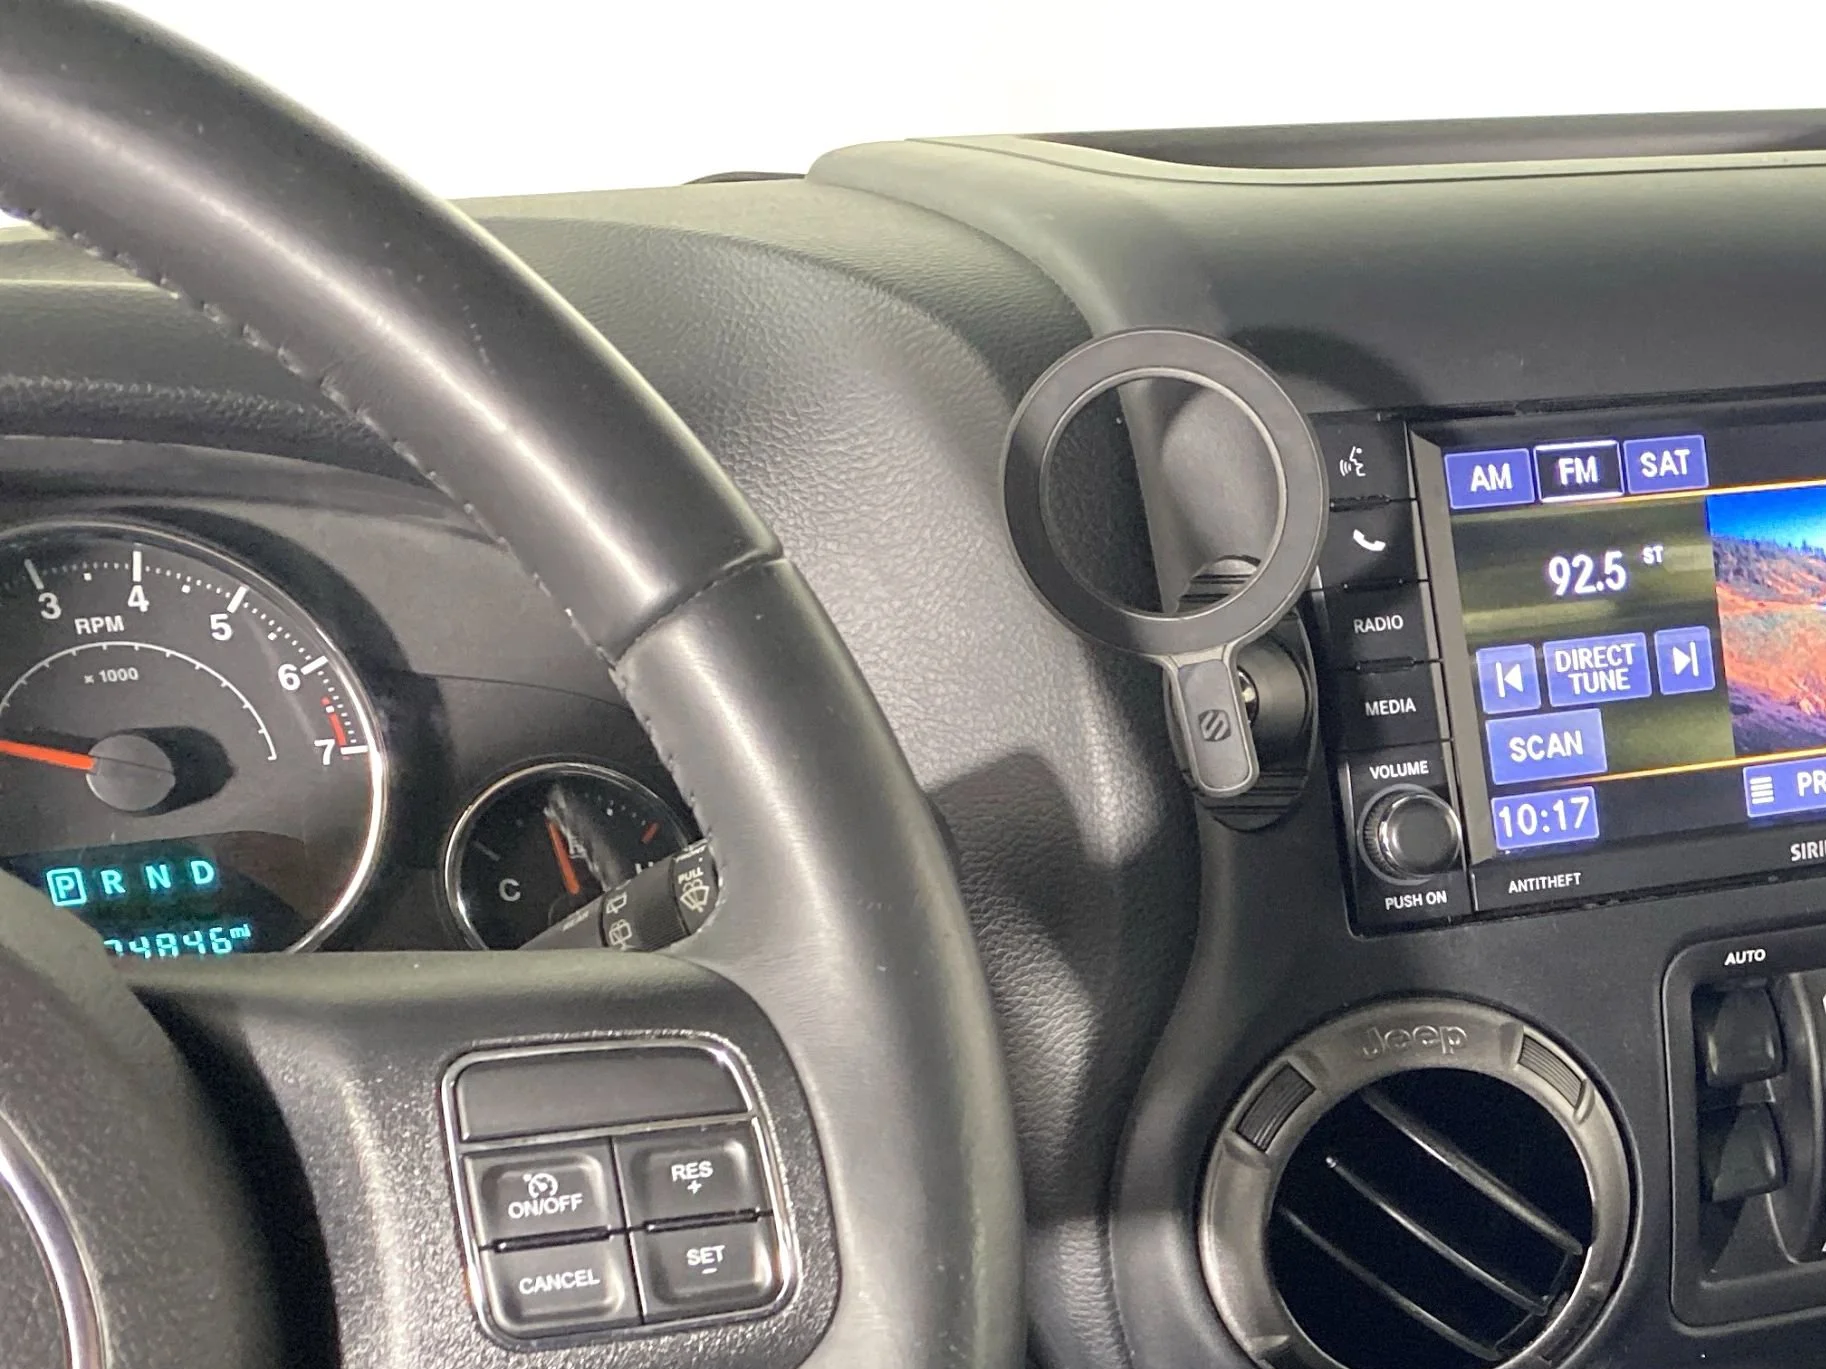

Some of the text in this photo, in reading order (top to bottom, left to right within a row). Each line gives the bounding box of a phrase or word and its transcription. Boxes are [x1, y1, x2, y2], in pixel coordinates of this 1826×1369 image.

[1558, 456, 1599, 485] FM
[1639, 449, 1691, 478] SAT
[1469, 463, 1513, 492] AM
[1548, 545, 1664, 596] 92.5 ST
[38, 592, 62, 620] 3
[127, 585, 149, 612] 4
[74, 615, 125, 635] RPM
[210, 613, 232, 640] 5
[1353, 614, 1404, 634] RADIO
[1555, 643, 1636, 672] DIRECT
[99, 667, 139, 683] 1000
[278, 663, 301, 690] 6
[1568, 667, 1631, 695] TUNE
[1364, 697, 1416, 716] MEDIA
[314, 739, 336, 765] 7
[1509, 730, 1584, 762] SCAN
[1369, 759, 1429, 780] VOLUME
[1499, 796, 1590, 838] 10:17
[56, 860, 215, 899] P R N D
[678, 867, 704, 884] PULL
[1507, 871, 1582, 894] ANTITHEFT
[499, 878, 521, 901] C
[1385, 890, 1448, 911] PUSH ON
[1724, 948, 1766, 966] AUTO
[1360, 1025, 1468, 1060] Jeep
[671, 1161, 714, 1181] RES
[508, 1193, 583, 1220] ON/OFF
[686, 1245, 726, 1266] SET
[518, 1269, 600, 1295] CANCEL
